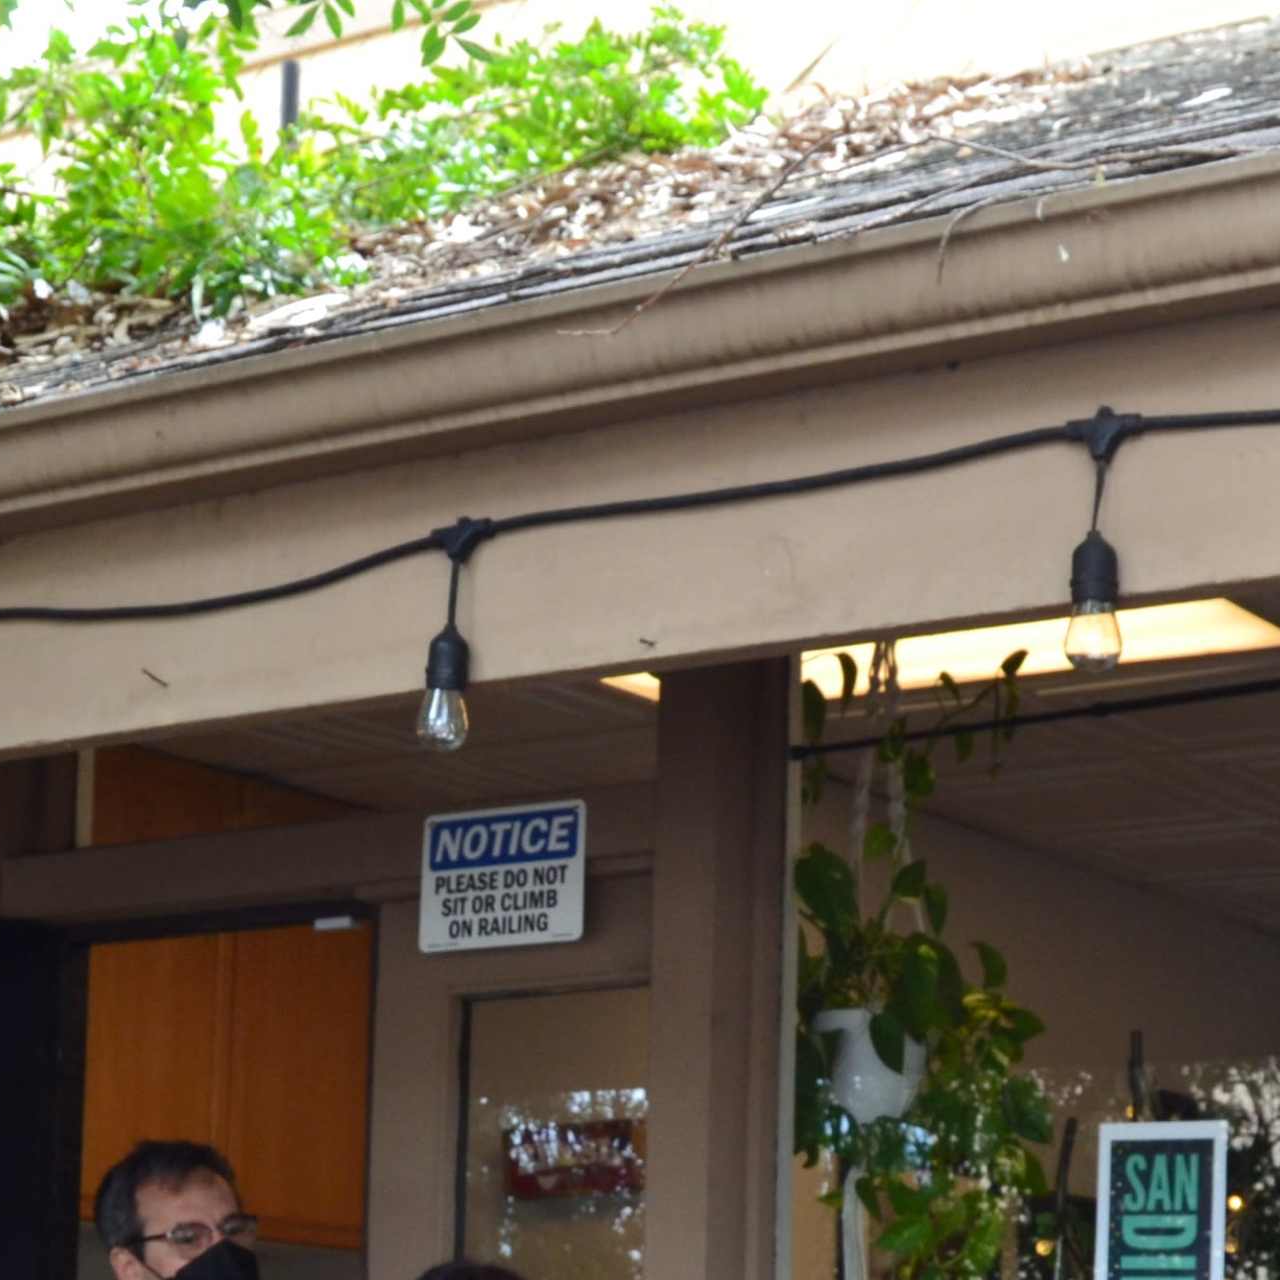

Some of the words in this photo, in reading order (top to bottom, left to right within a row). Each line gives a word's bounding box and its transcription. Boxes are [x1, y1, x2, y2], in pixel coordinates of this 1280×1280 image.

[434, 815, 575, 863] NOTICE
[434, 870, 499, 895] PLEASE
[503, 868, 528, 888] DO
[532, 864, 568, 886] NOT
[441, 897, 467, 917] SIT
[471, 895, 496, 914] OR
[500, 889, 558, 912] CLIMB
[448, 919, 472, 939] ON
[477, 913, 549, 937] RAILING
[1122, 1153, 1199, 1213] SAN
